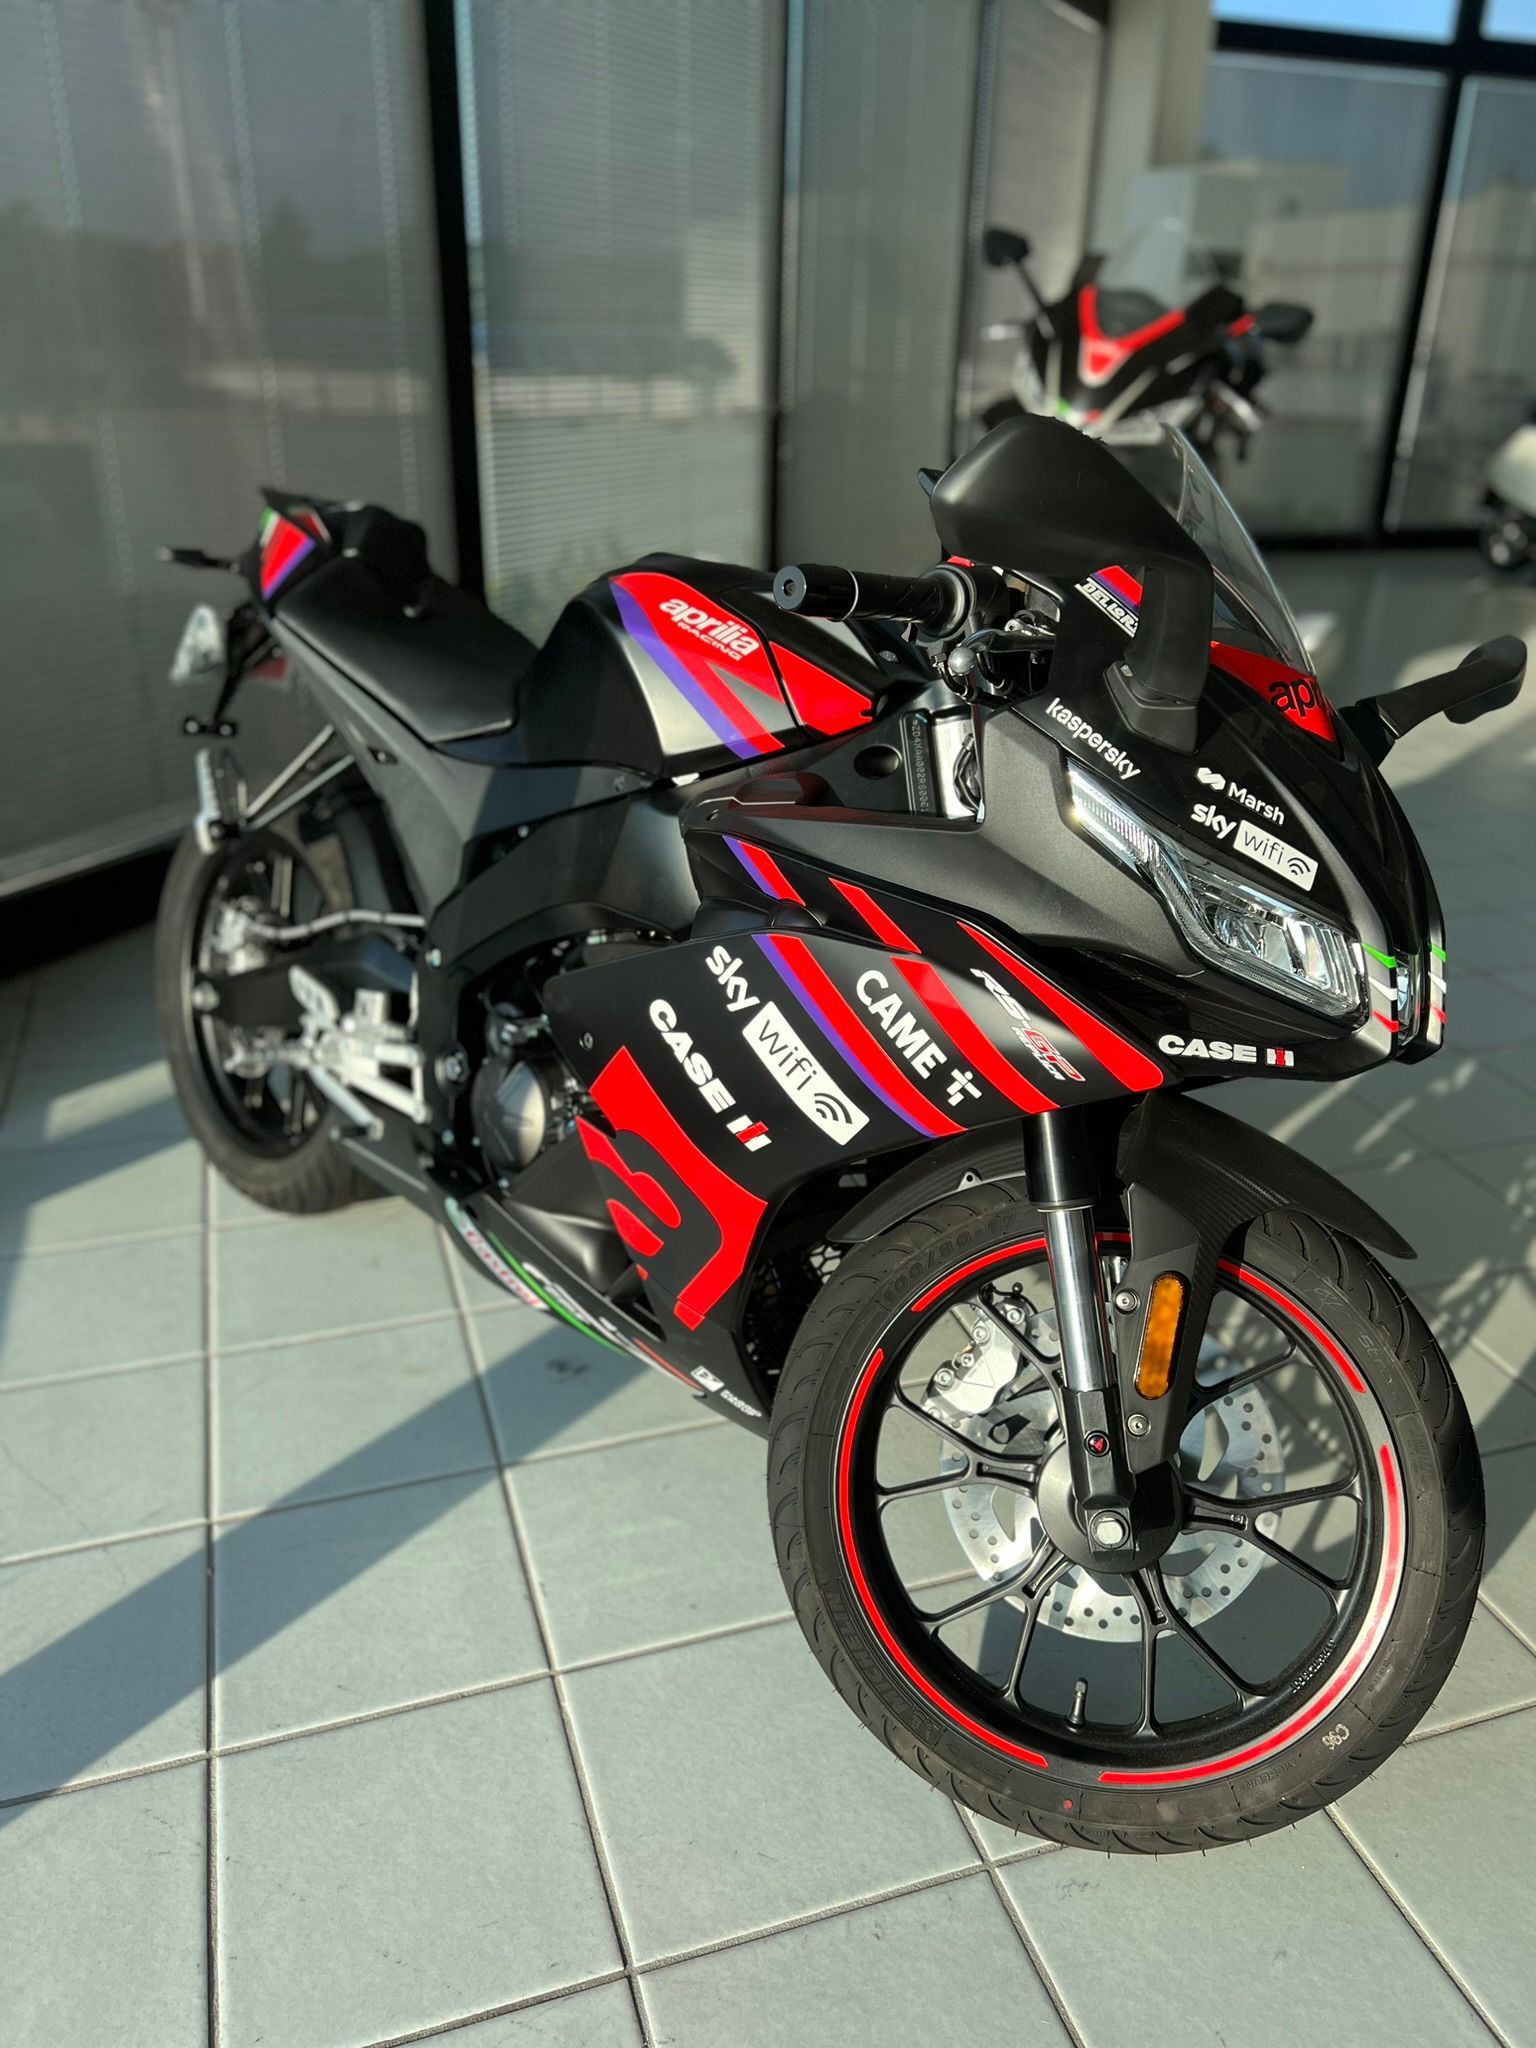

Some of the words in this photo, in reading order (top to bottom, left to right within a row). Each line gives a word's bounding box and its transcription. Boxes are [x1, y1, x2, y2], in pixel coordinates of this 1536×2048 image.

[659, 598, 760, 657] aprilia
[677, 621, 744, 662] RACING
[1045, 697, 1142, 780] kaspersky
[1191, 802, 1238, 840] sky
[1243, 830, 1285, 866] wifi
[1226, 782, 1285, 826] Marsh
[705, 945, 760, 1012] sky
[758, 1019, 817, 1091] wifi
[855, 969, 948, 1080] CAME
[1157, 1034, 1257, 1064] CASE
[649, 999, 736, 1114] CASE
[1012, 1025, 1066, 1081] REPLICA
[825, 1591, 914, 1716] MICHELIN
